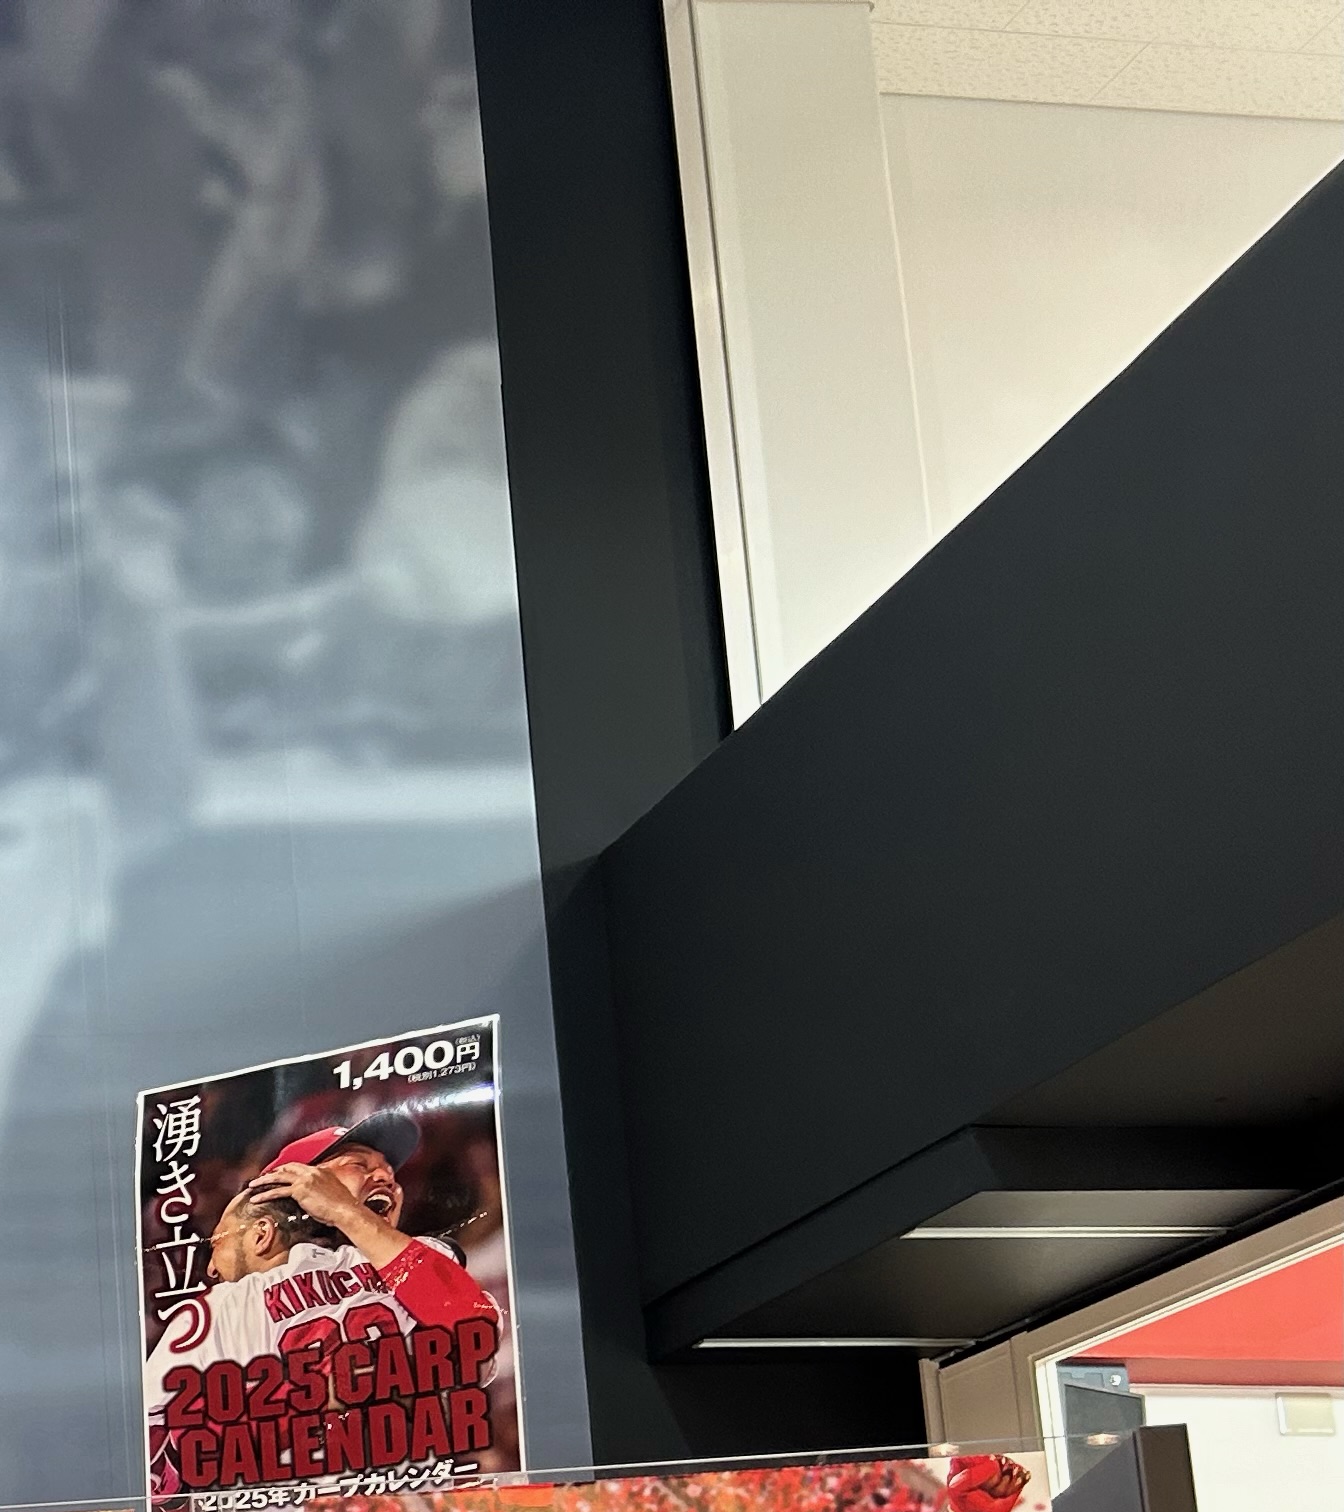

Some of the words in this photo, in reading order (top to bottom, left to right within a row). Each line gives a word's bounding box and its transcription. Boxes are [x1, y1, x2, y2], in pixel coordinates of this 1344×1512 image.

[333, 1040, 480, 1090] 1,400円
[150, 1095, 211, 1353] 湧き立つ
[163, 1354, 328, 1428] 2025
[334, 1317, 499, 1405] CARP
[180, 1388, 491, 1488] CALENDAR
